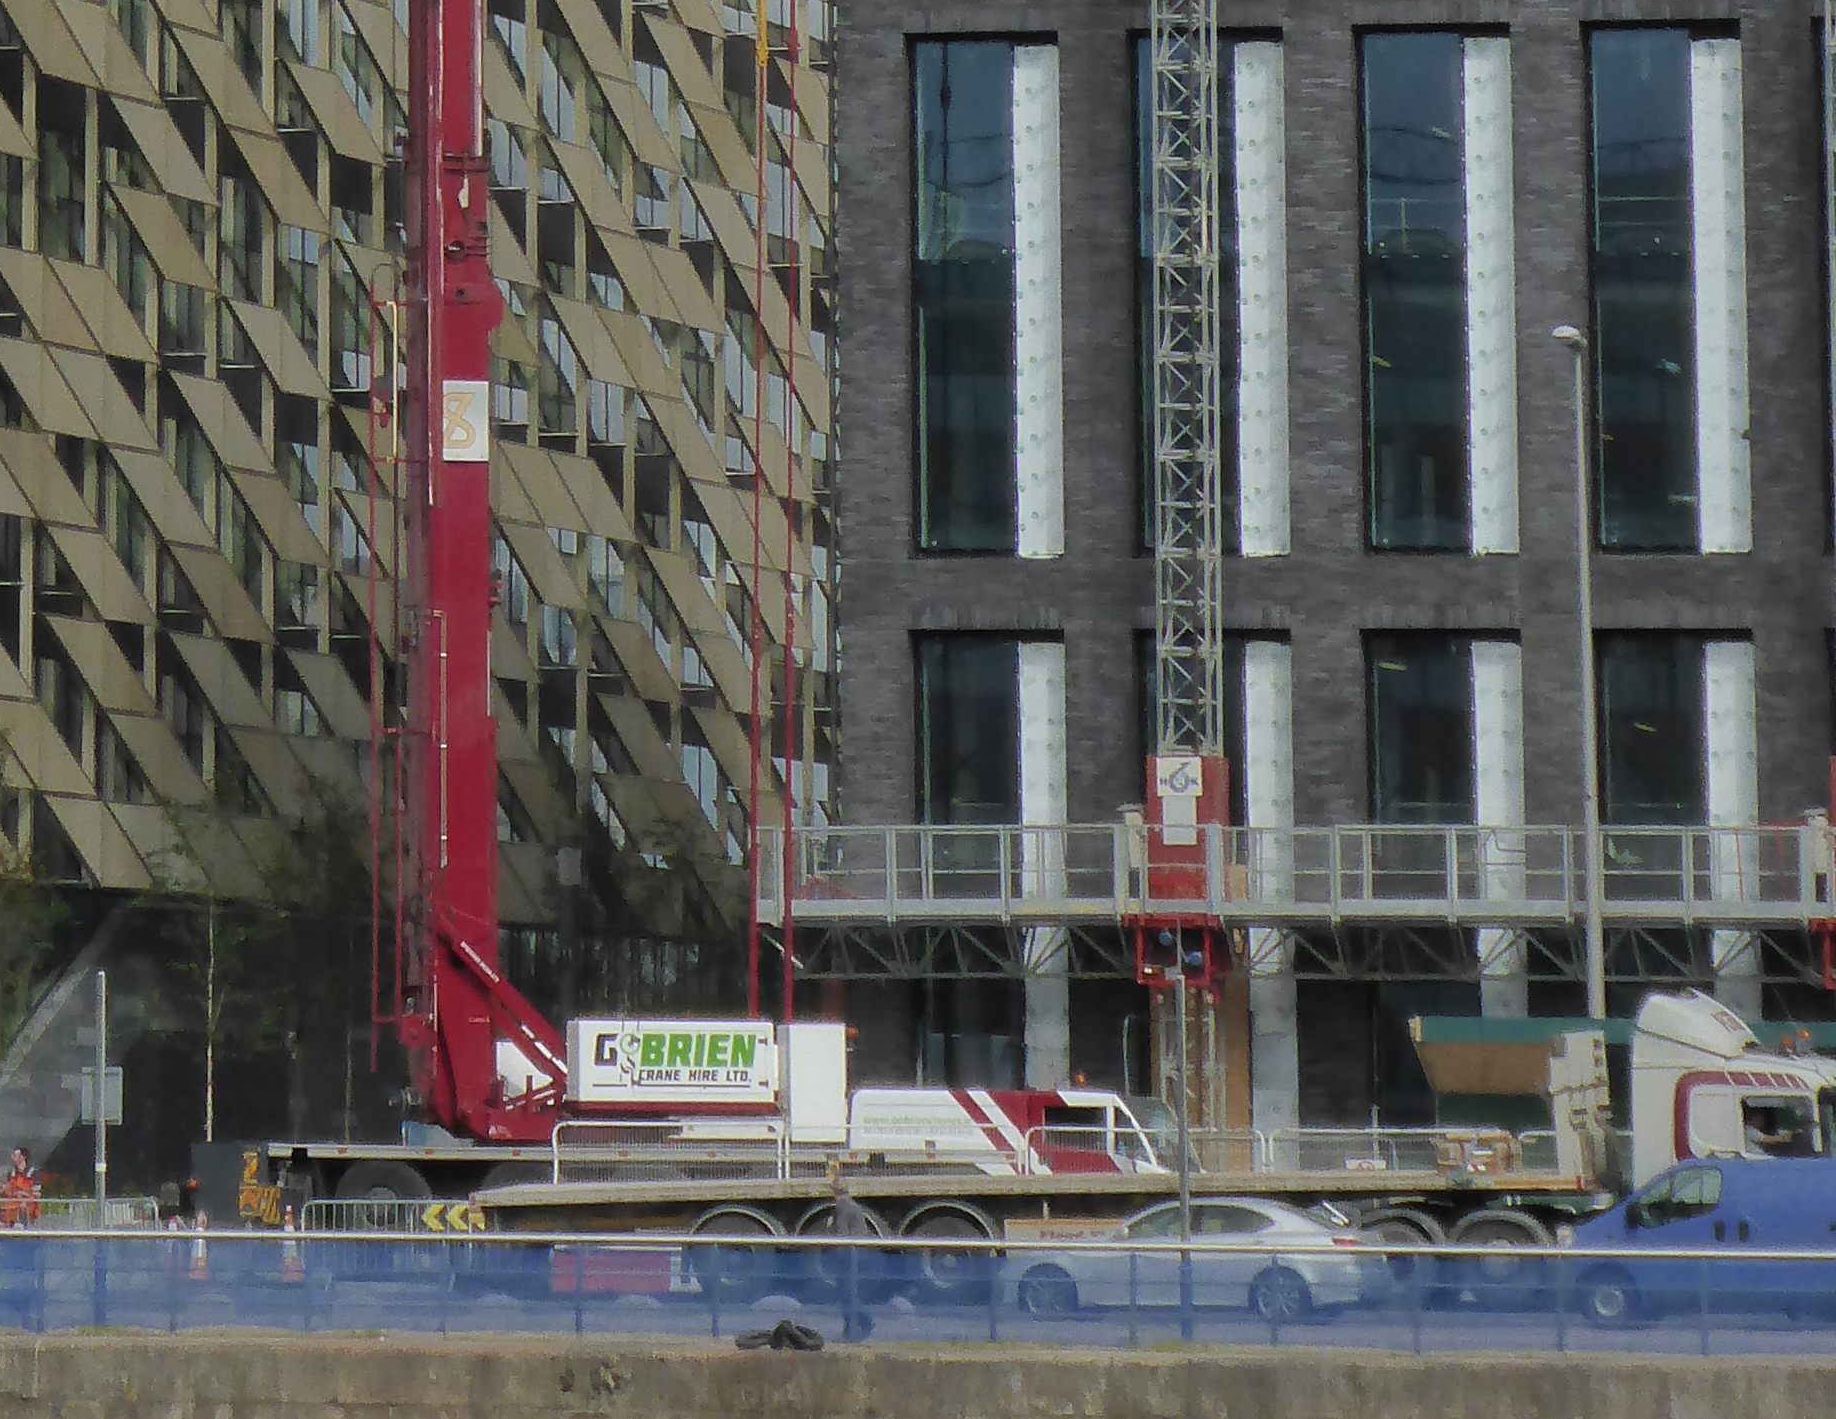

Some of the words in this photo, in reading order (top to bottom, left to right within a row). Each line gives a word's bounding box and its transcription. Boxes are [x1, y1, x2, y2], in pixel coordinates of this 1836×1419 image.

[638, 1069, 680, 1082] CRANE
[689, 1069, 719, 1081] HIRE
[726, 1069, 752, 1082] LTD.
